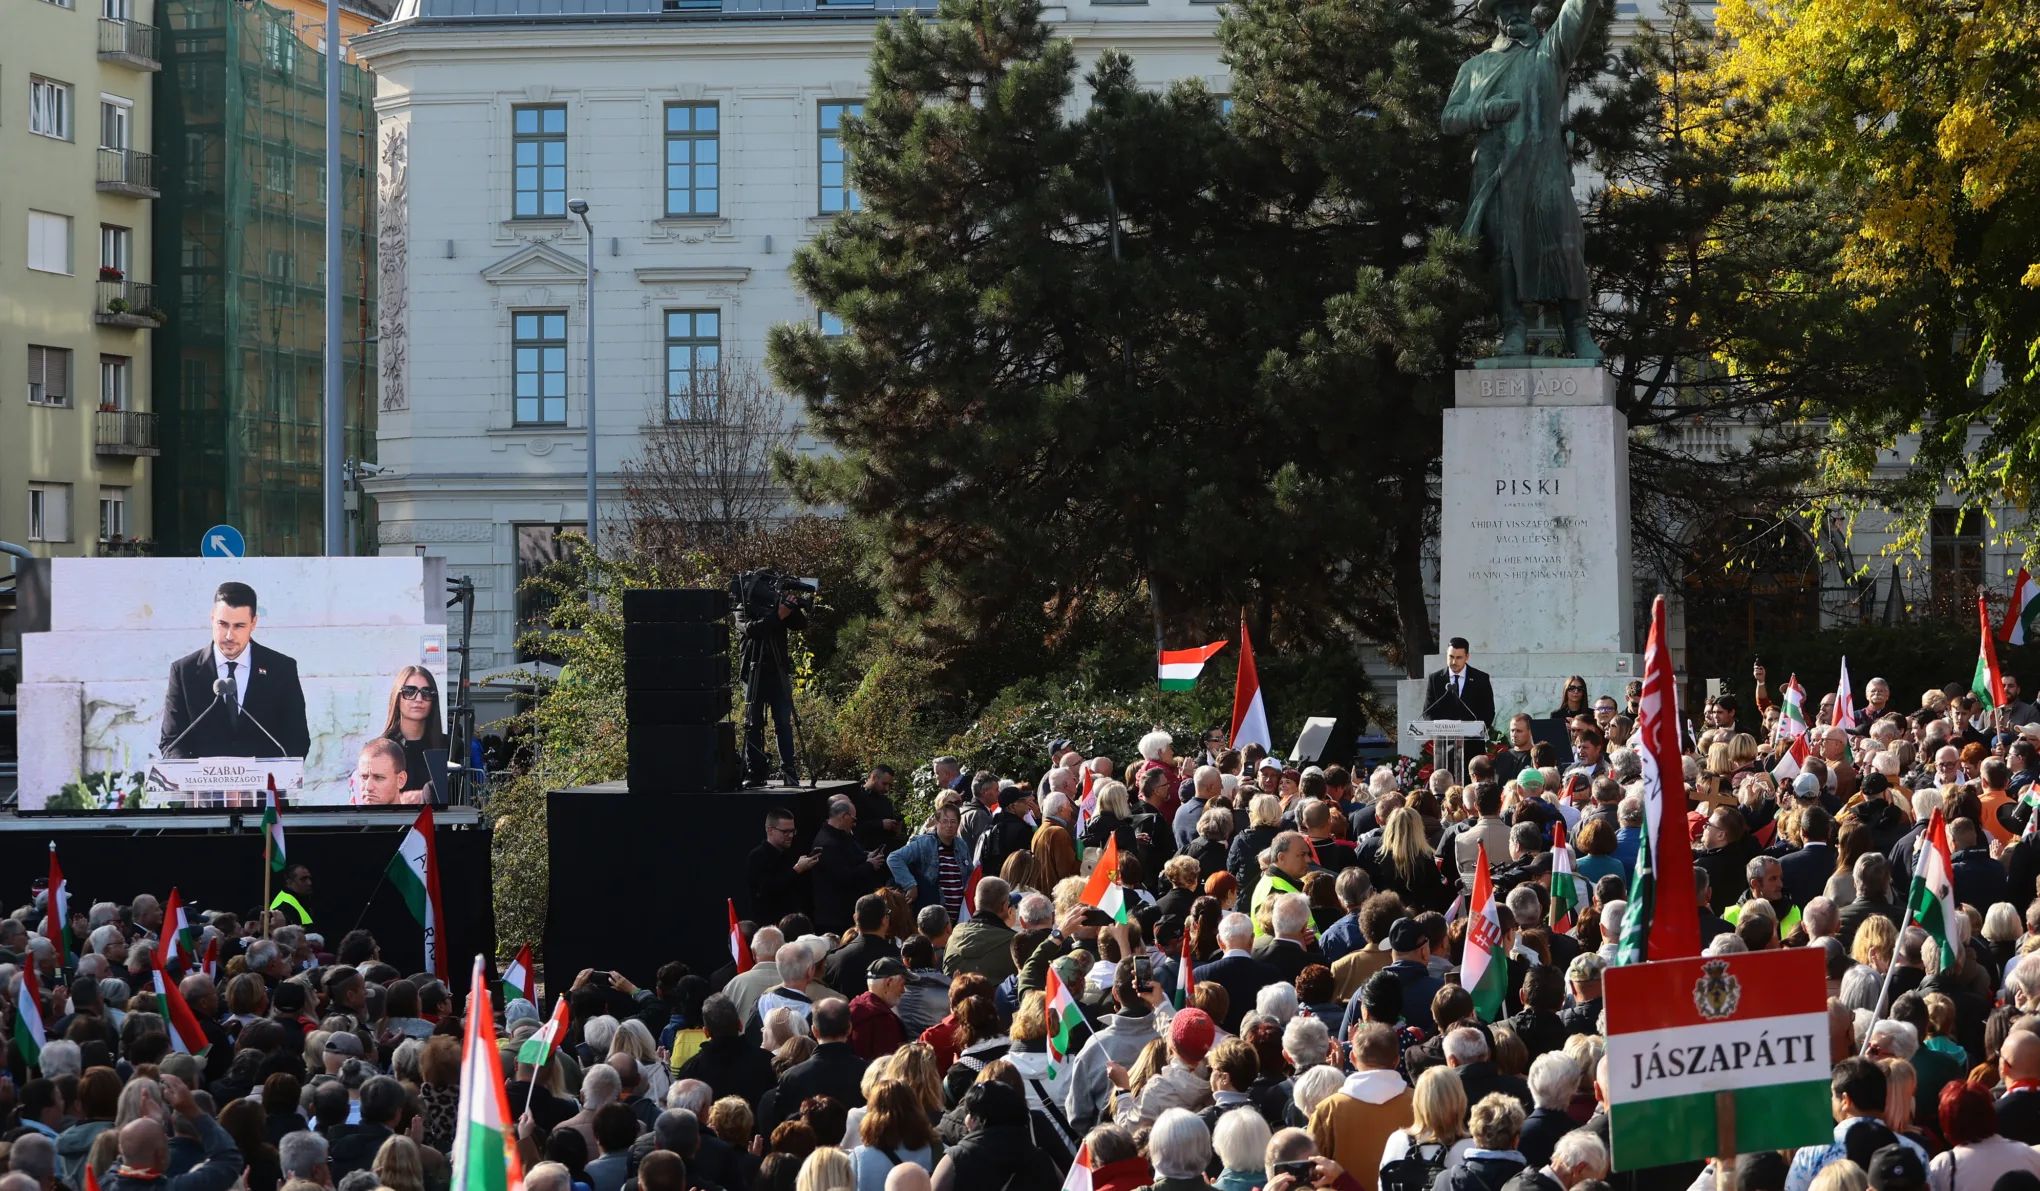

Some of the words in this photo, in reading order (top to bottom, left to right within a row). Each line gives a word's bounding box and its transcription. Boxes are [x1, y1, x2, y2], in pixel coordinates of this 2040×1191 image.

[1481, 379, 1526, 397] BEM
[1496, 479, 1560, 496] PISKI
[203, 766, 245, 776] SZABAD
[1631, 1030, 1815, 1089] JÁSZAPÁTI
